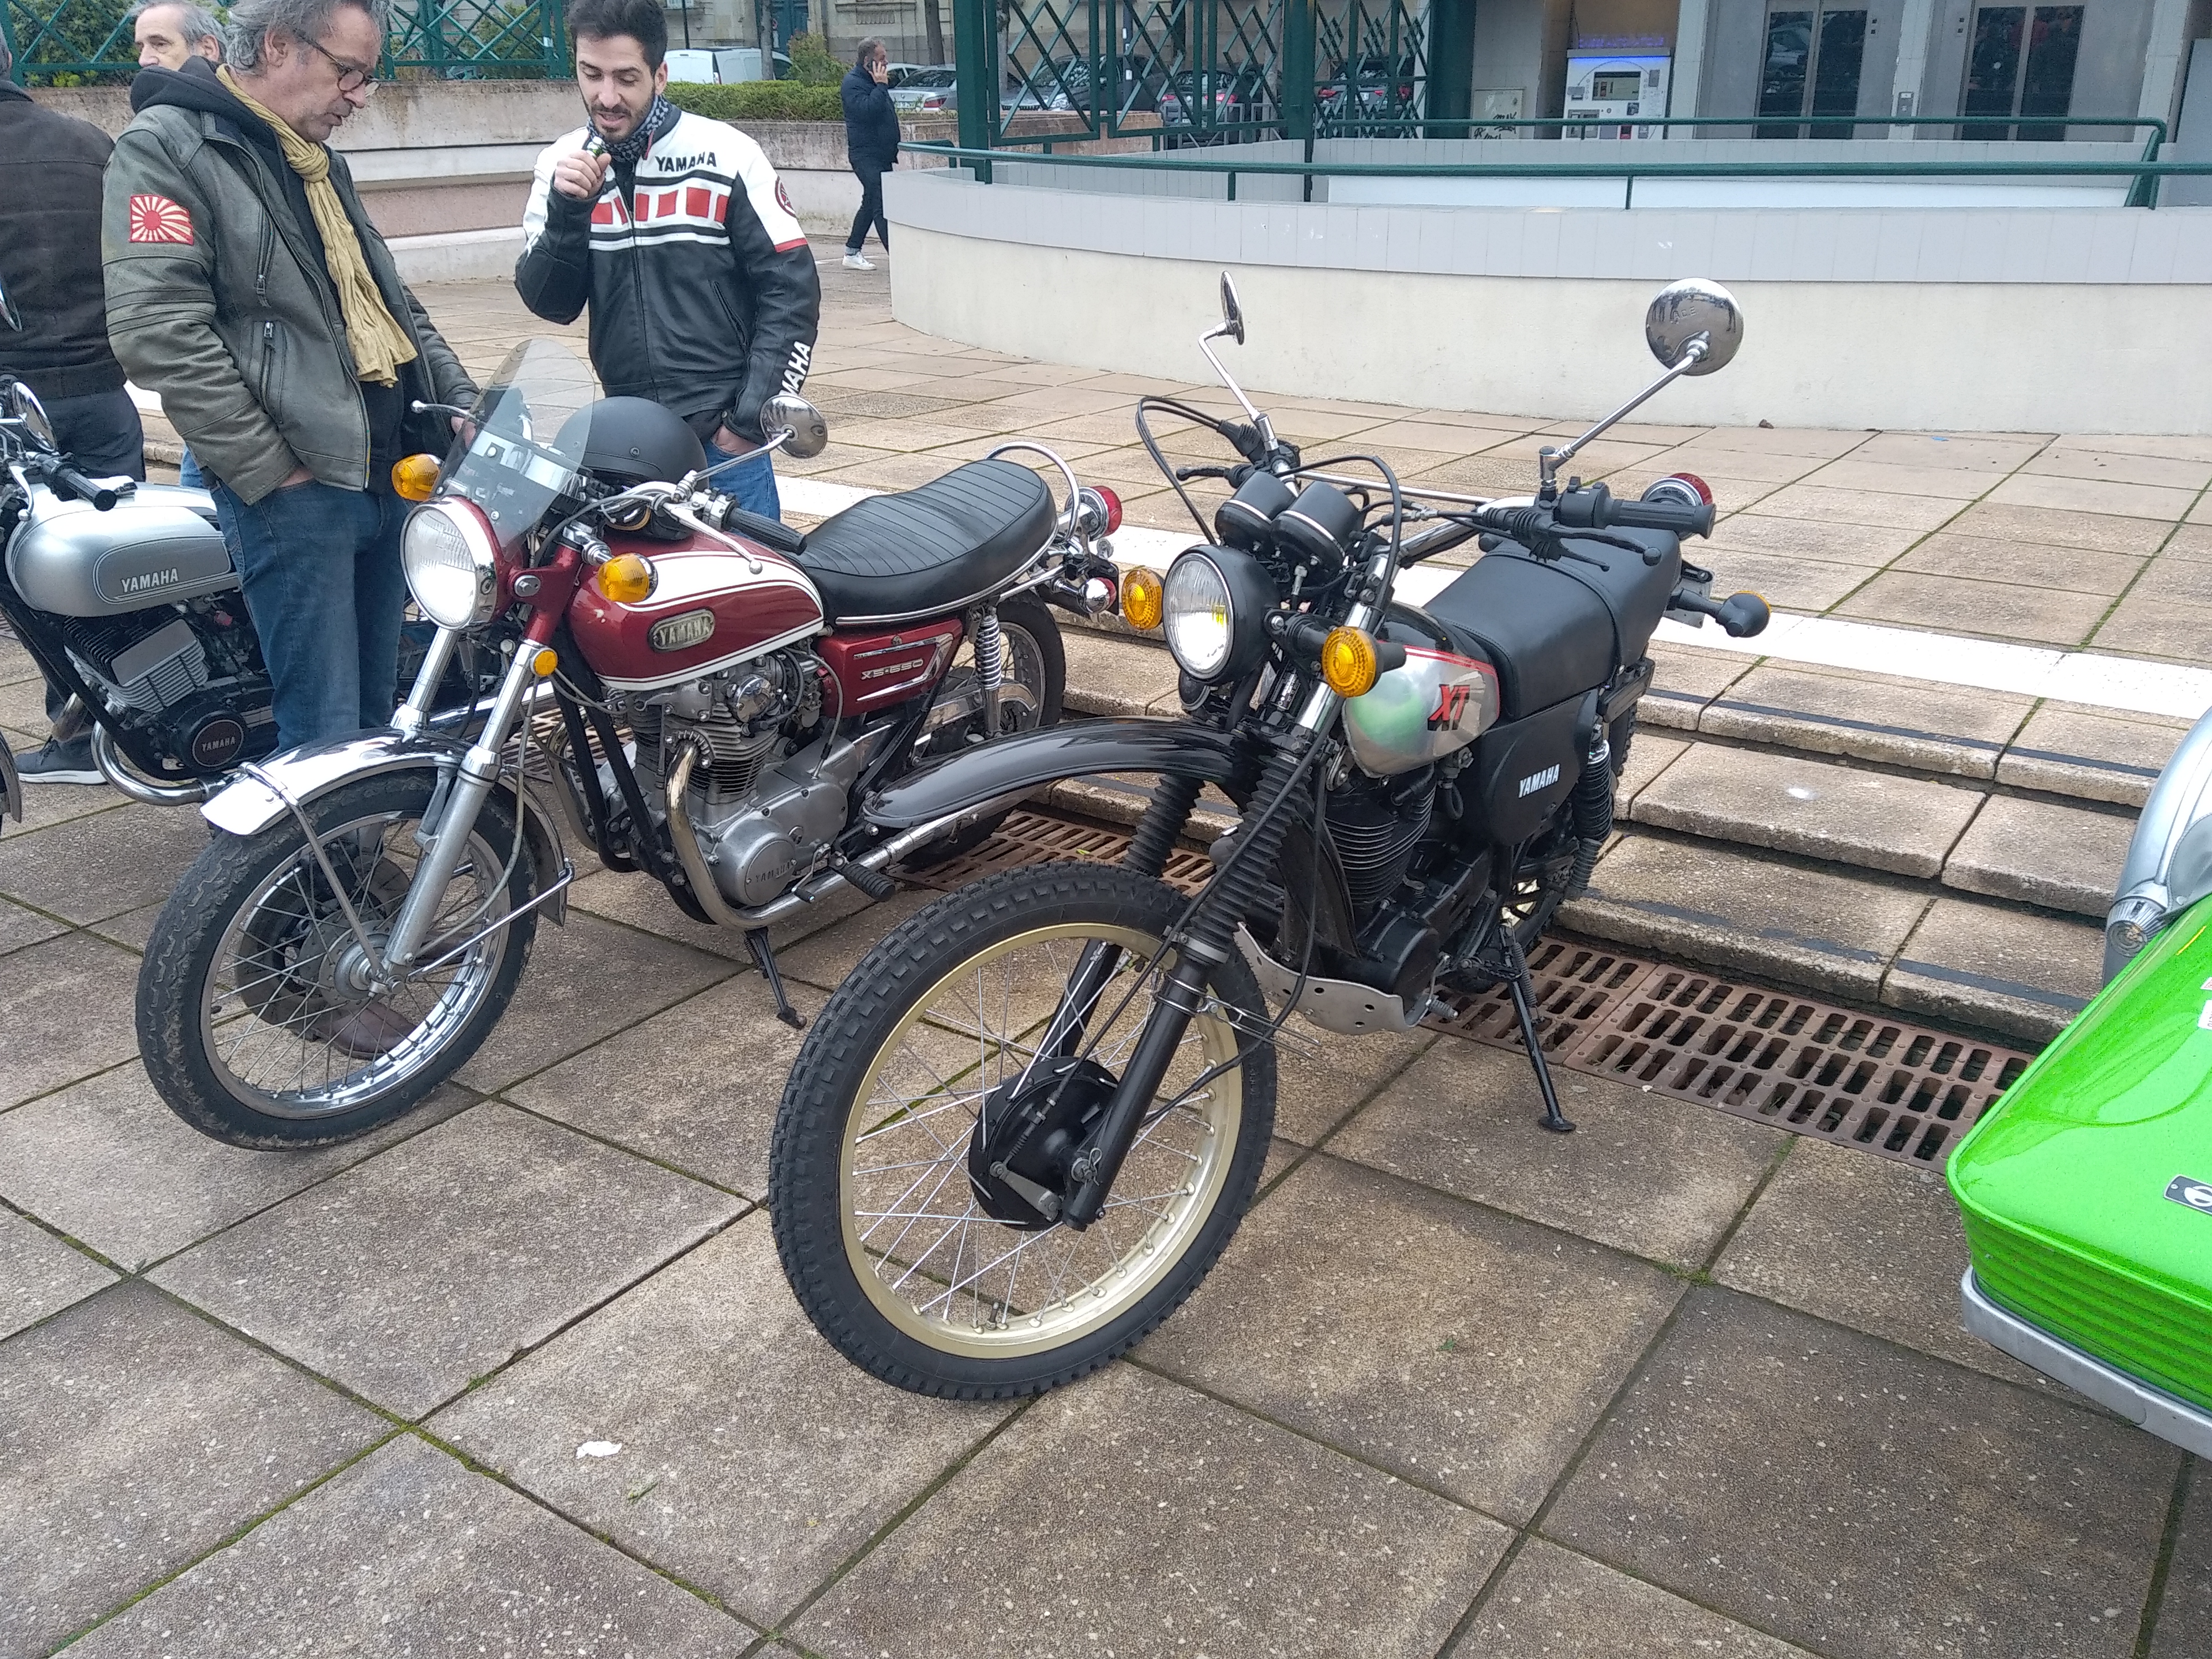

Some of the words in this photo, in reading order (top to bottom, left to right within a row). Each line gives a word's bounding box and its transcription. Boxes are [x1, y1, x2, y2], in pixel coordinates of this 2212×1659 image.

[655, 152, 717, 172] YAMAHA
[121, 568, 179, 593] YAMAHA
[659, 616, 710, 645] YAMAHA
[1427, 684, 1470, 731] XT
[202, 736, 236, 753] YAMAHA
[1519, 763, 1560, 798] YAMAHA
[755, 862, 790, 882] YAMAHA
